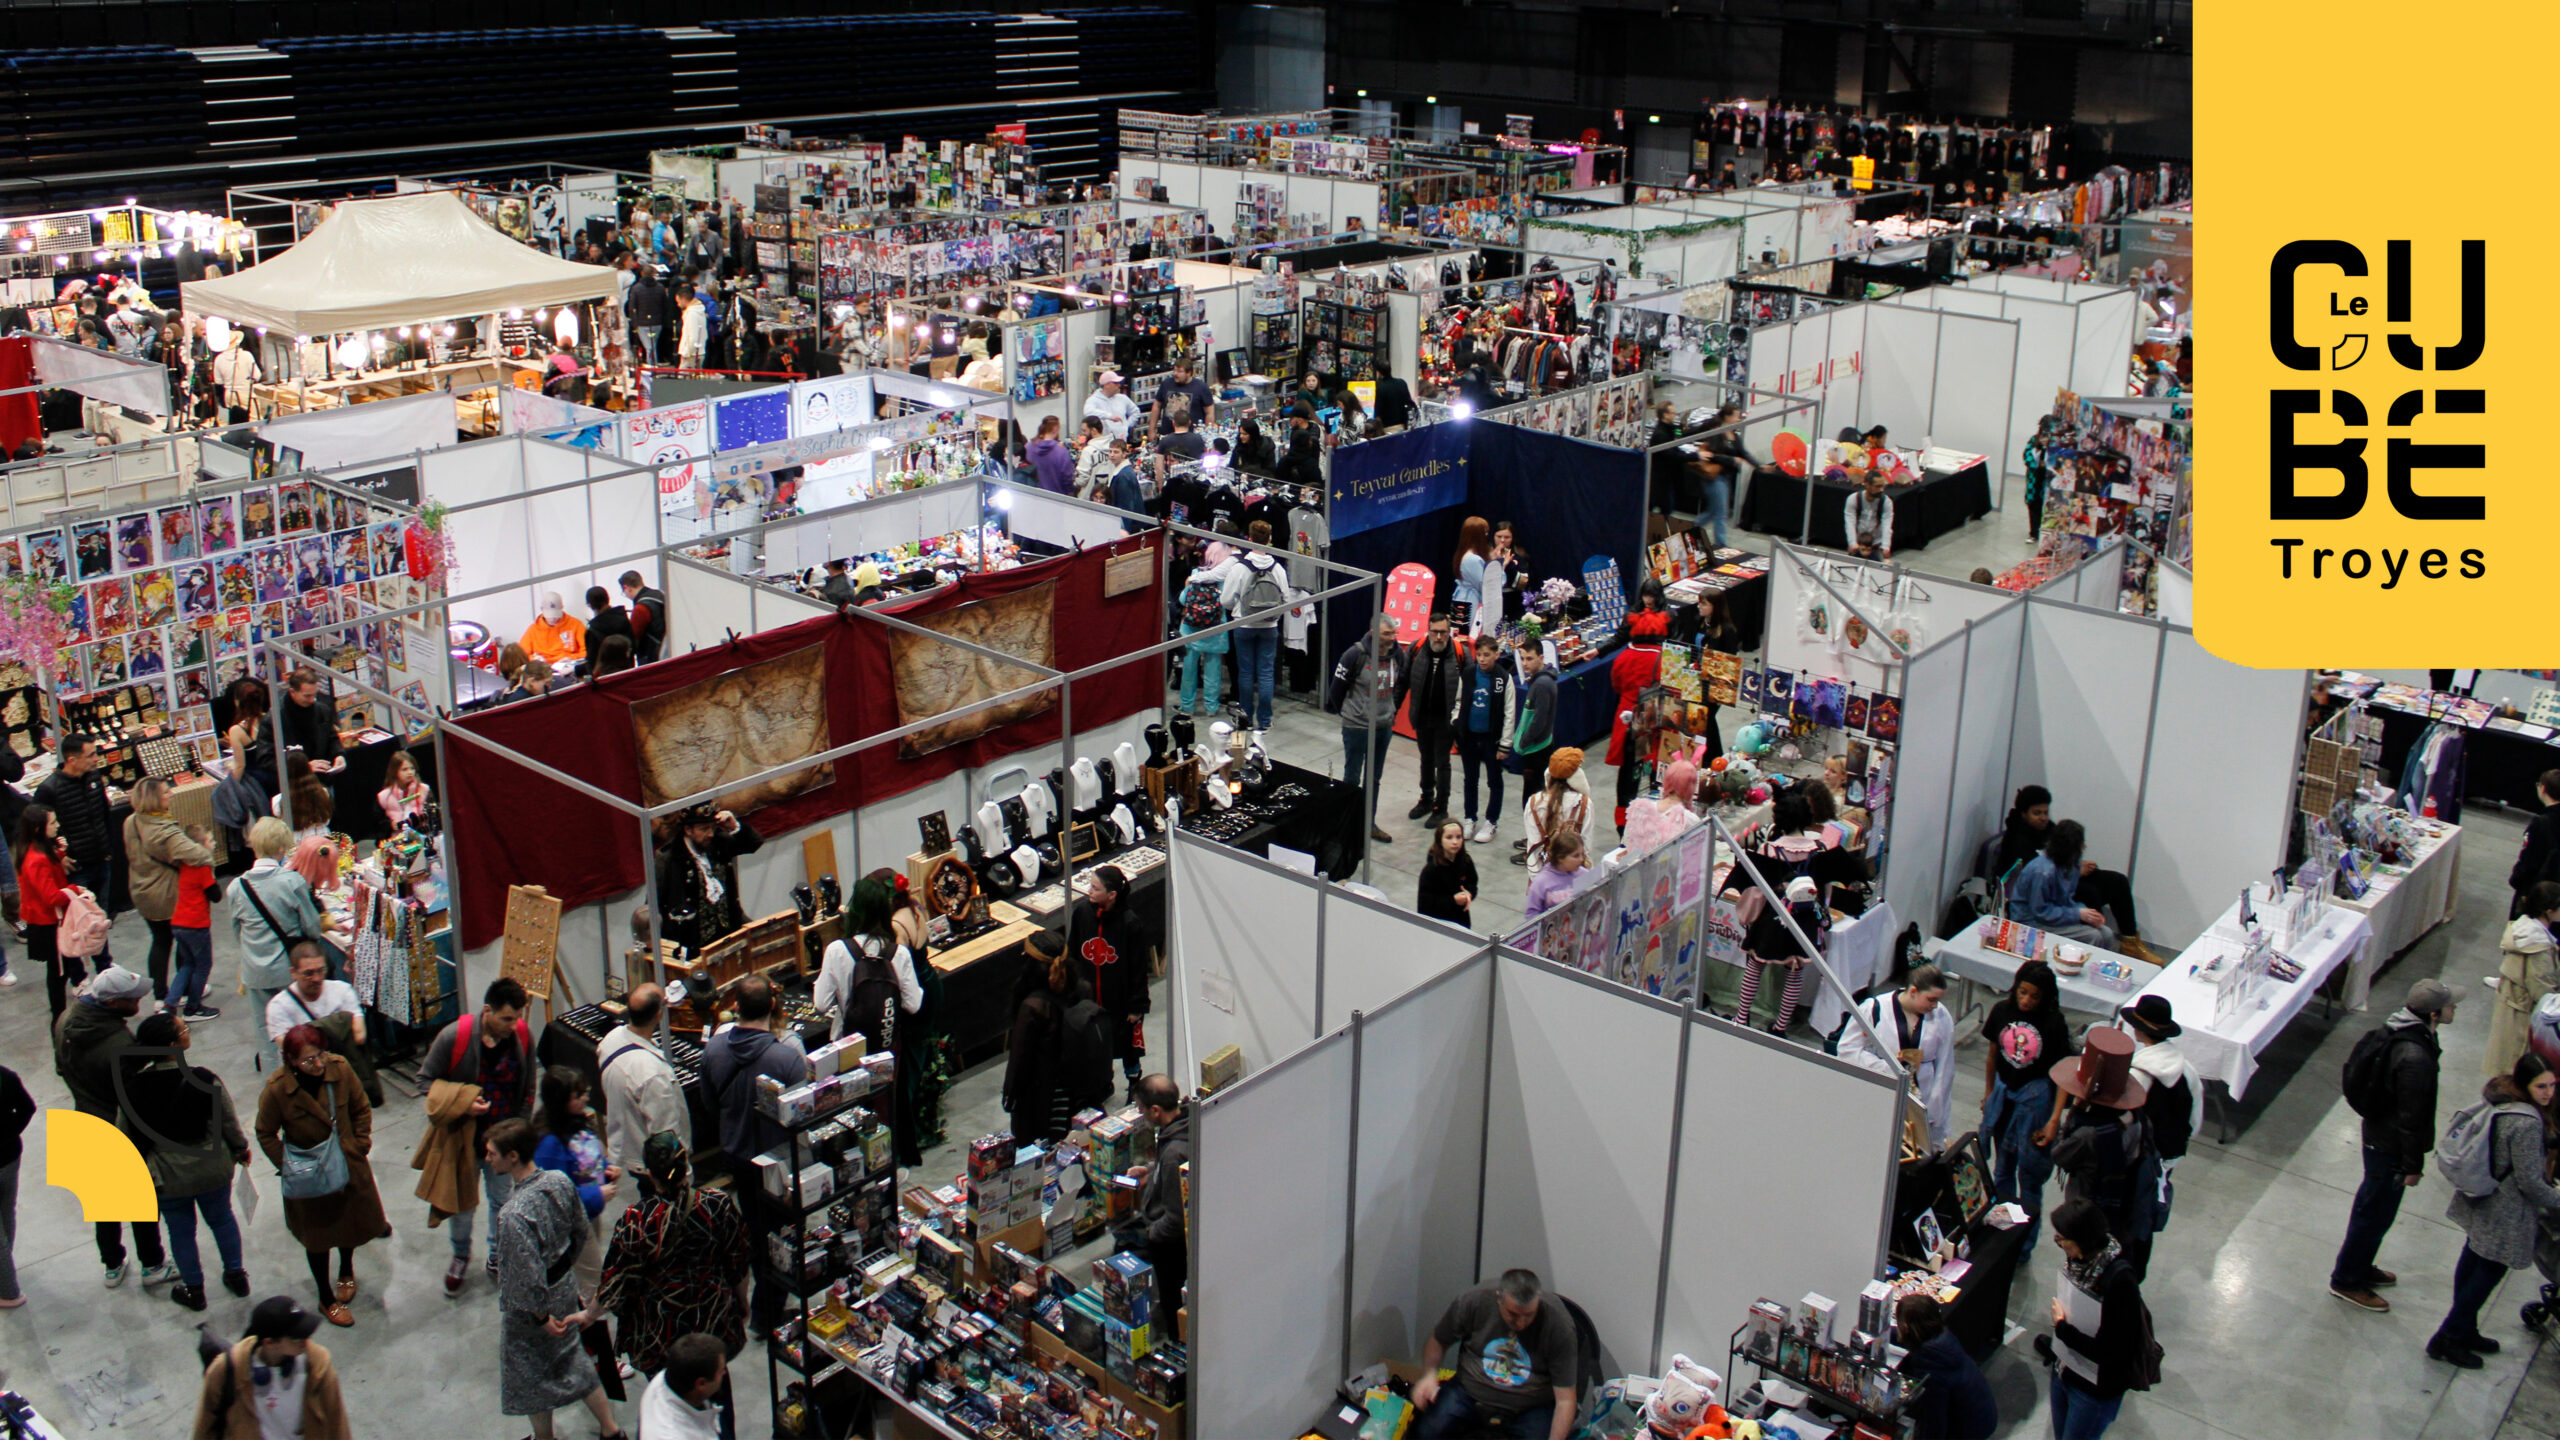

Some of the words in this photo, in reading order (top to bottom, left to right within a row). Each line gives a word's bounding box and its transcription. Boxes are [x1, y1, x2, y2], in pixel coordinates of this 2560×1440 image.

[803, 435, 846, 457] Sophie
[1350, 473, 1396, 499] Teyvat
[1399, 459, 1451, 484] Candles
[881, 996, 895, 1048] adidas
